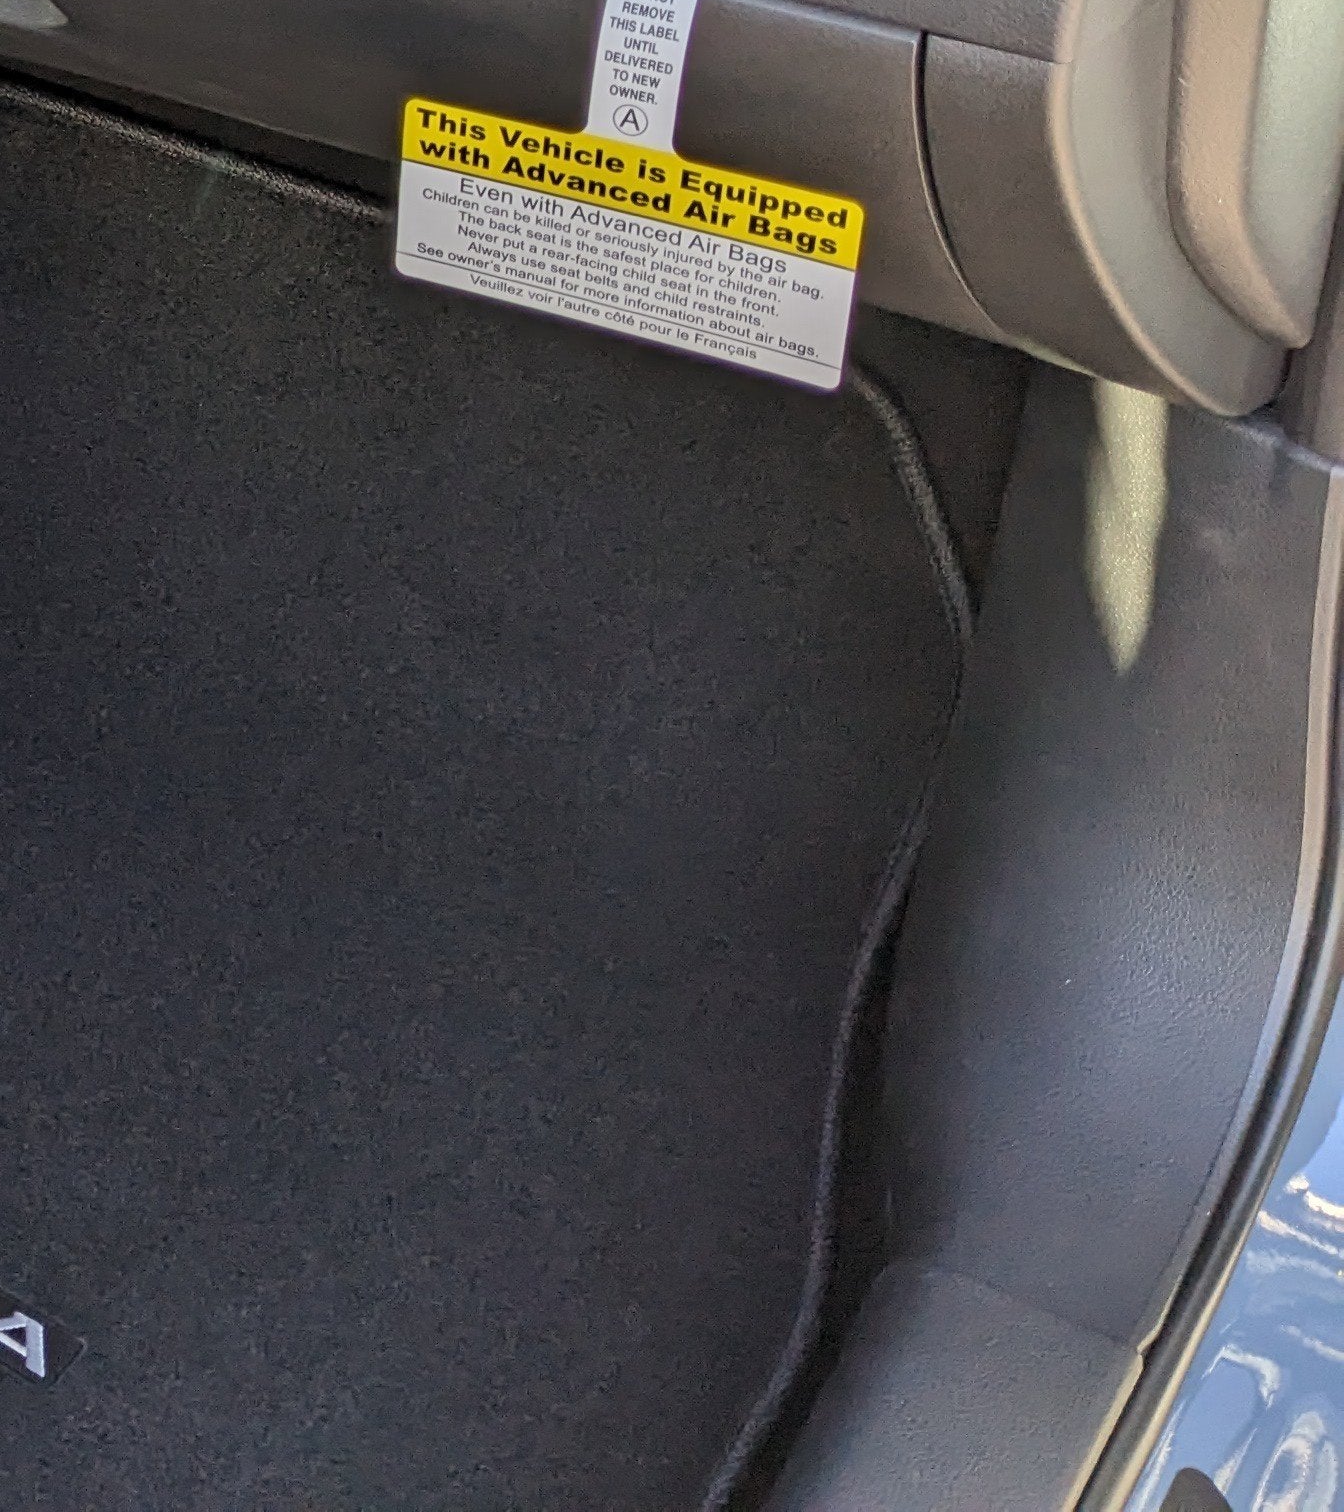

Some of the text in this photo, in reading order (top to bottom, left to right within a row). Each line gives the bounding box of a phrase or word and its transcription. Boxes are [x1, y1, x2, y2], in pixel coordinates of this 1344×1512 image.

[610, 16, 679, 42] THIS LABEL
[622, 2, 675, 23] REMOVE
[624, 37, 659, 54] UNTIL
[604, 50, 674, 74] DELIVERED
[609, 85, 658, 105] OWNER.
[613, 68, 661, 88] TO NEW
[620, 108, 640, 131] A
[417, 108, 847, 228] This Vehicle is Equipped
[420, 140, 836, 254] with Advanced Air Bags
[422, 188, 823, 300] Children can be killed or seriously injured by the air bag.
[458, 210, 781, 303] The back seat is the safest place for children.
[460, 177, 786, 273] Even with Advanced Air Bags
[417, 242, 818, 358] See owner's manual for more information about air bags.
[458, 224, 778, 317] Never put a rear-facing child seat in the front.
[468, 241, 764, 328] Always use seat belts and child restraints.
[470, 273, 757, 359] Veuillez voir l'autre côté pour le Français
